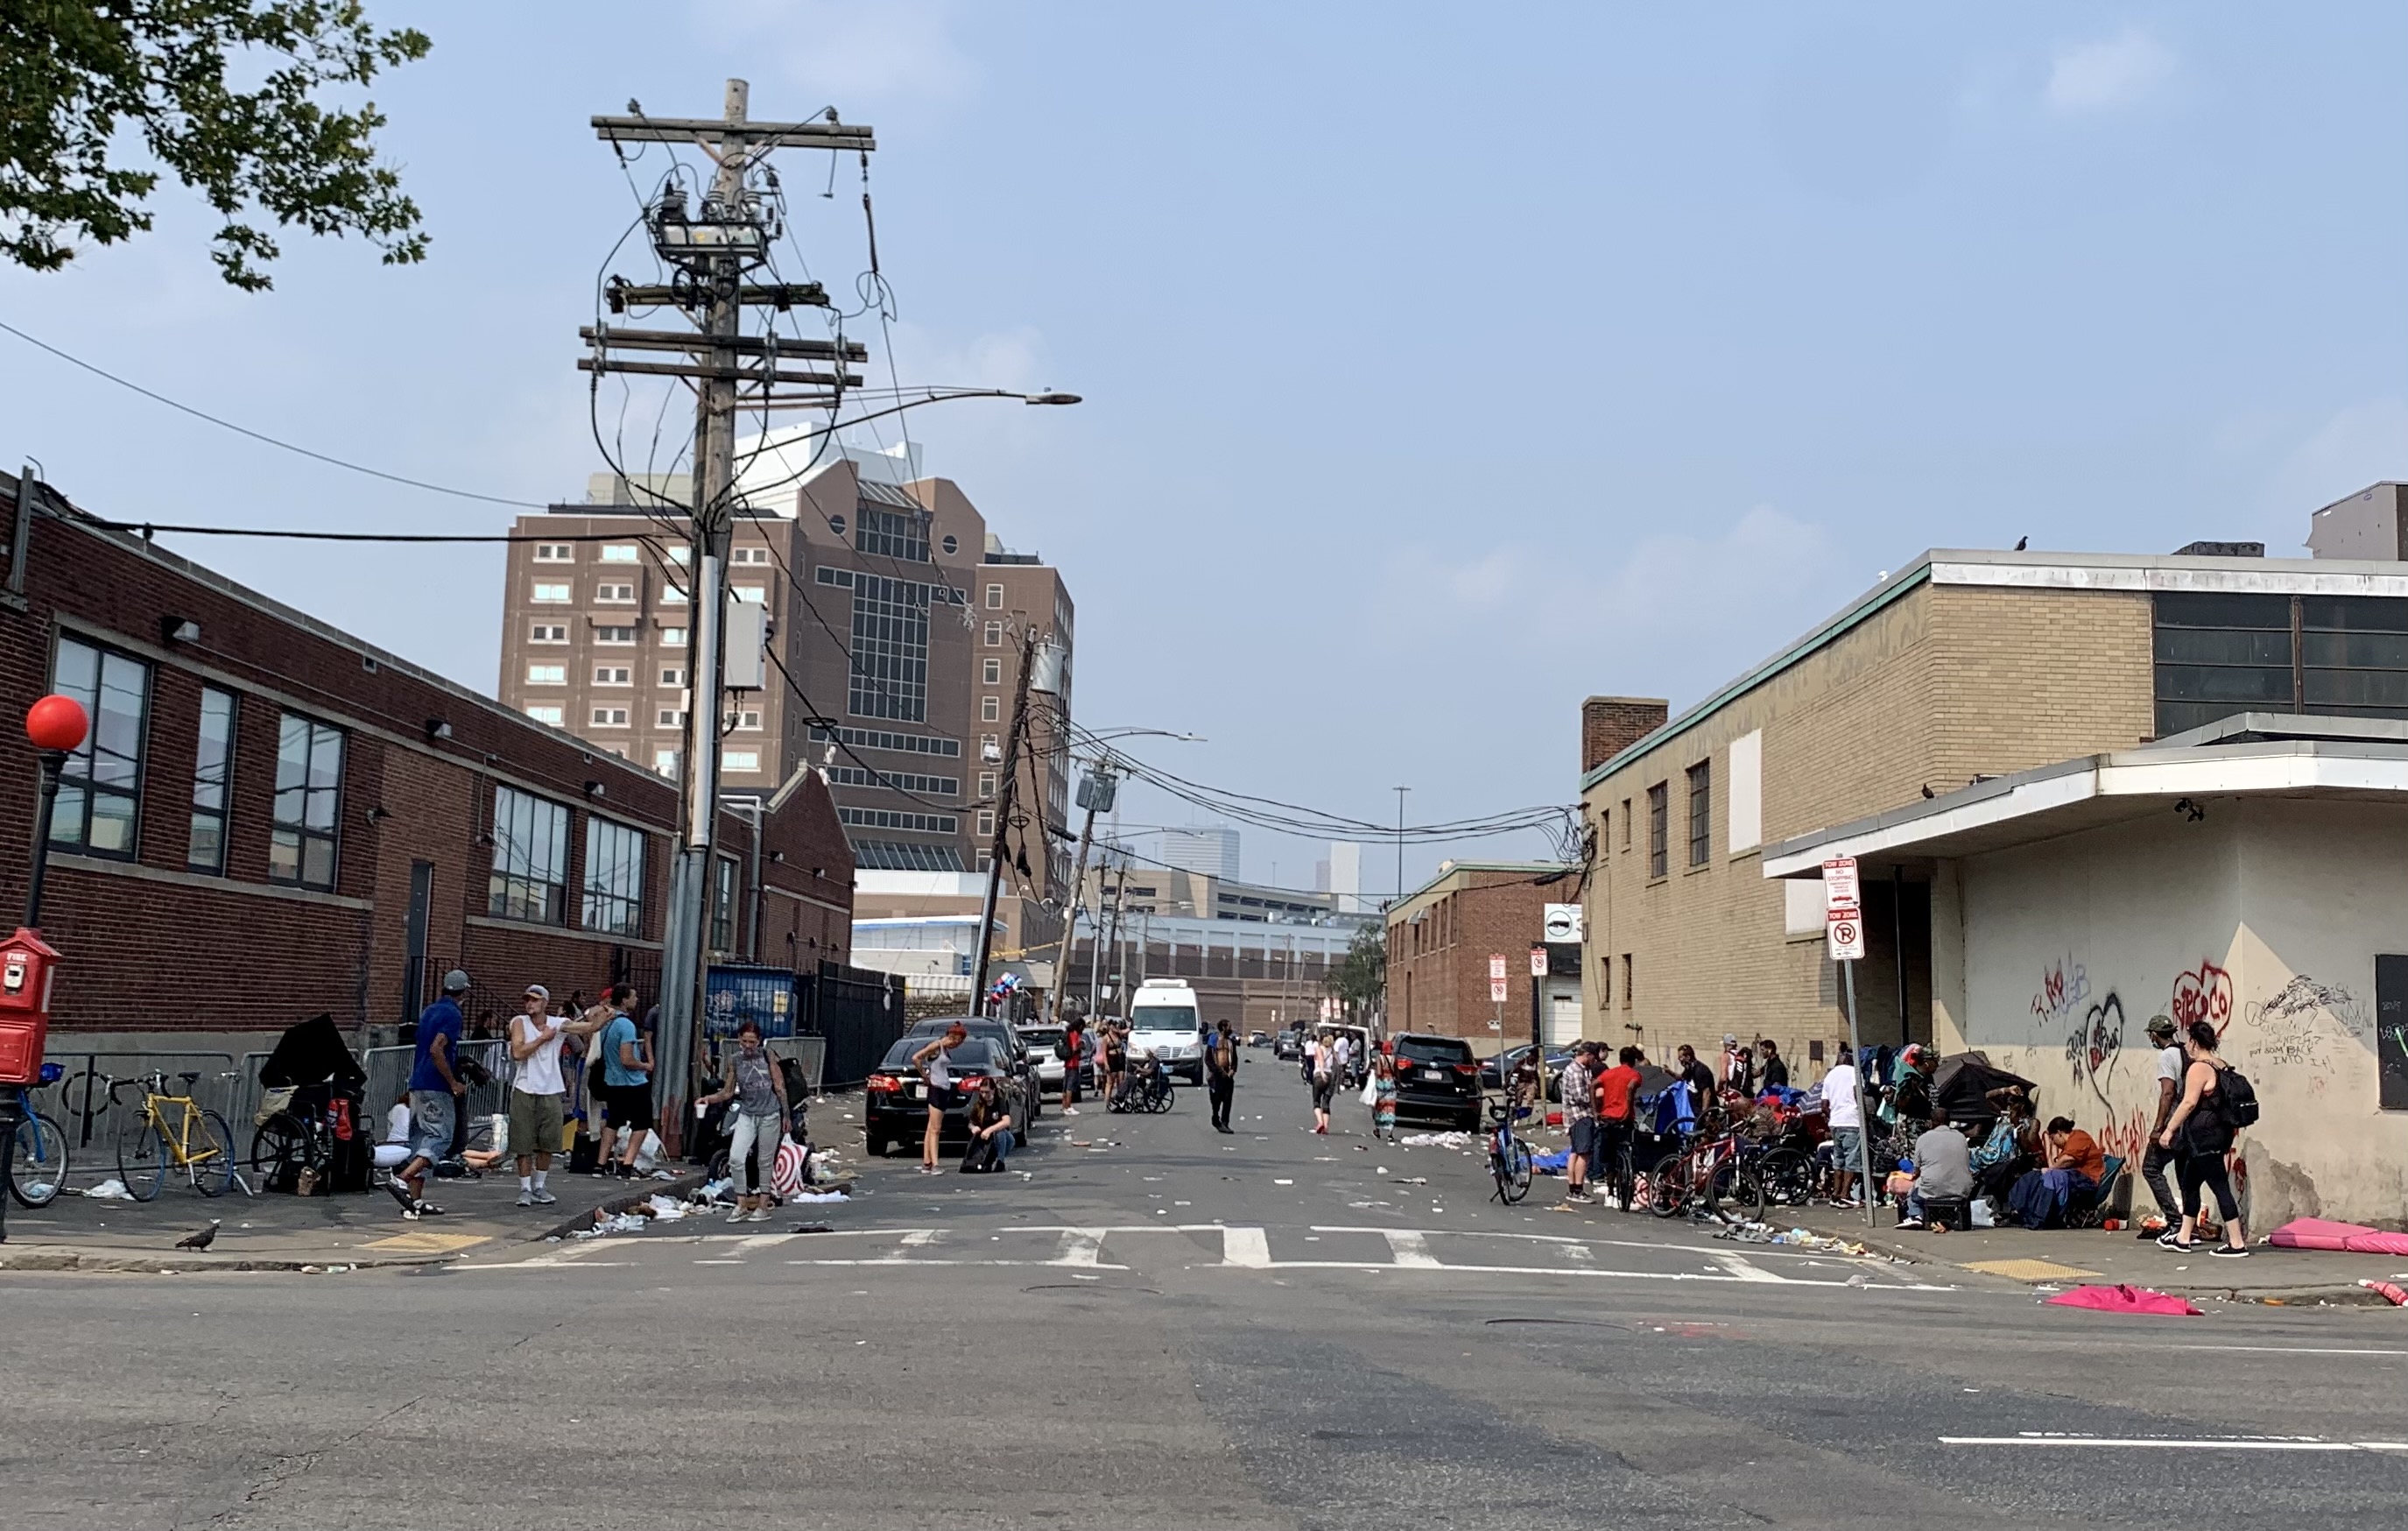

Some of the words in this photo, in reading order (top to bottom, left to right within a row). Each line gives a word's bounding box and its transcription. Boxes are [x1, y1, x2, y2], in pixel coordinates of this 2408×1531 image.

[7, 952, 28, 962] FIRE
[2286, 1045, 2314, 1055] BACK
[2272, 1054, 2304, 1065] INTO
